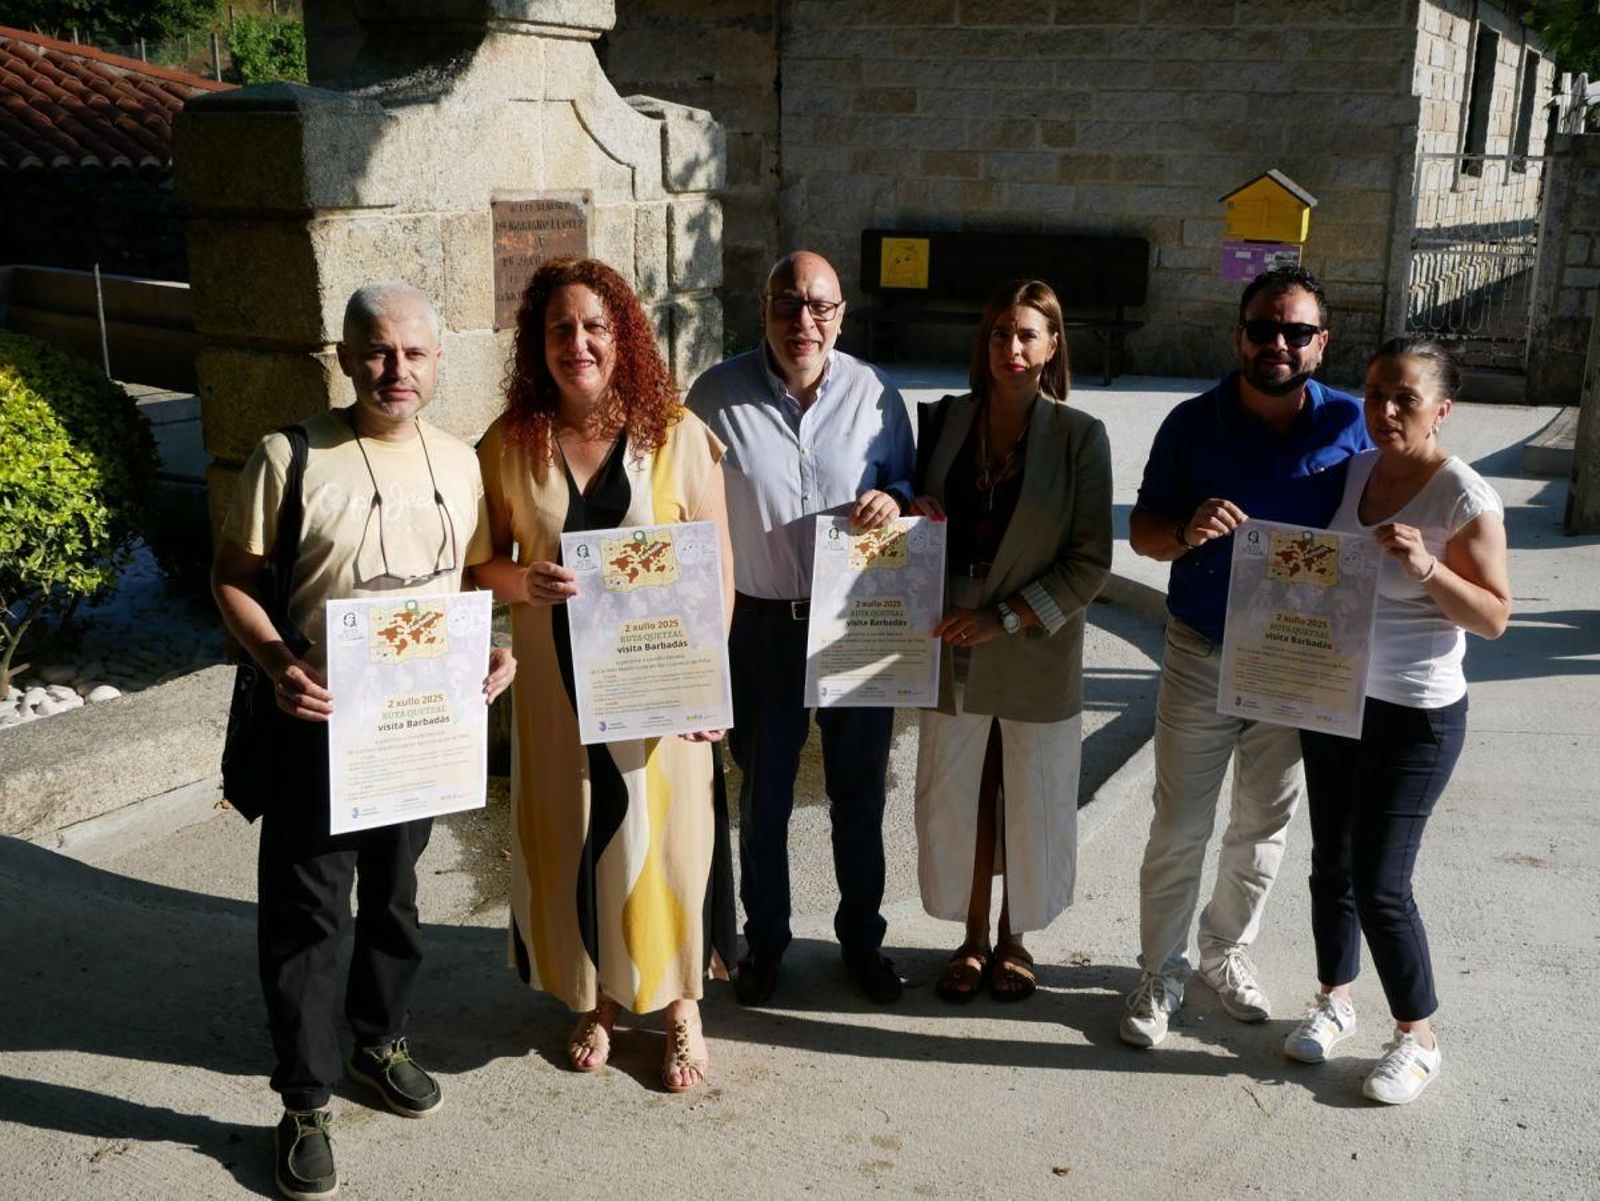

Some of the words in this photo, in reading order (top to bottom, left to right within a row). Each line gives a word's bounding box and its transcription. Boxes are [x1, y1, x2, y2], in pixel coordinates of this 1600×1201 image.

[855, 600, 860, 608] 2
[883, 600, 902, 608] 2025
[624, 624, 630, 632] 2
[632, 622, 656, 631] xullo
[658, 619, 679, 629] 2025
[1276, 613, 1282, 621] 2
[1307, 619, 1328, 629] 2025
[620, 634, 643, 643] RUTA
[644, 631, 683, 642] QUETZAL
[1265, 632, 1289, 642] visita
[617, 644, 643, 654] visita
[645, 639, 688, 651] Barbadás
[388, 700, 394, 708] 2
[396, 696, 420, 707] xullo
[422, 694, 443, 704] 2025
[382, 710, 405, 720] RUTA
[378, 722, 404, 731] visita
[407, 715, 450, 728] Barbadás
